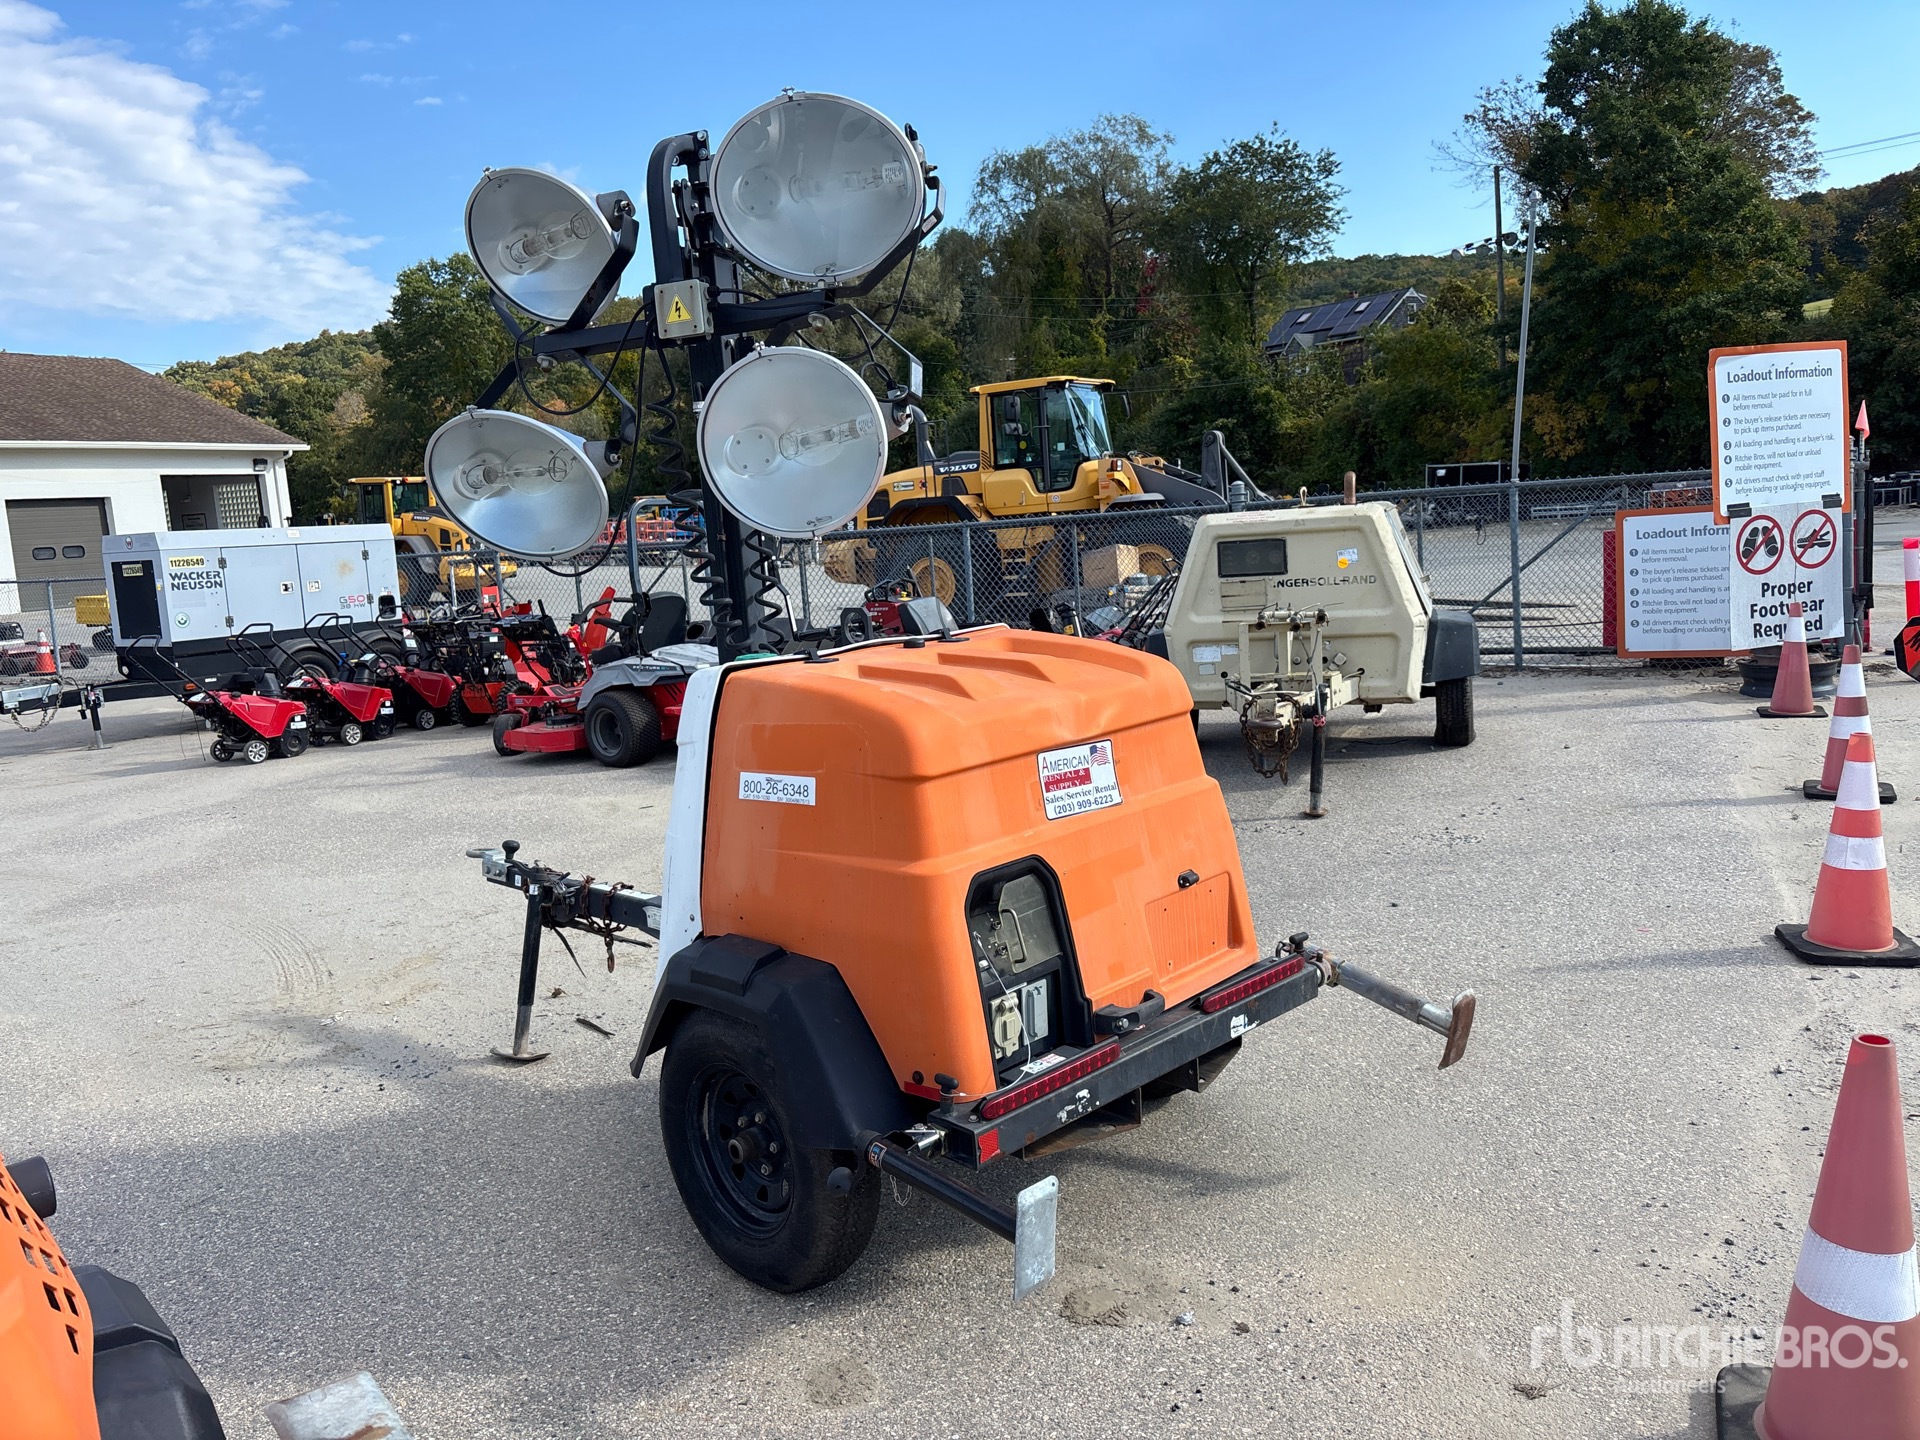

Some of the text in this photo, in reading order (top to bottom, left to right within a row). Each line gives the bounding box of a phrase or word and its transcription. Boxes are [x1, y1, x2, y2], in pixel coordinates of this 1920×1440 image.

[1727, 364, 1832, 383] Loadout Information
[1741, 393, 1756, 401] items
[1757, 392, 1770, 400] must
[1771, 391, 1778, 399] be
[1778, 390, 1790, 400] paid
[1732, 403, 1750, 411] before
[1734, 418, 1743, 426] The
[1744, 416, 1763, 426] buyer's
[1764, 415, 1782, 423] release
[1782, 414, 1798, 422] tickets
[1808, 412, 1831, 420] necessary
[1740, 426, 1751, 435] pick
[1753, 426, 1760, 434] up
[1743, 440, 1762, 448] loading
[1764, 438, 1773, 446] and
[1774, 437, 1796, 446] handling
[1808, 434, 1824, 443] buyer's
[938, 463, 978, 473] VOLVO
[1754, 462, 1782, 472] equipment.
[1802, 472, 1813, 480] yard
[1736, 486, 1752, 494] before
[1753, 485, 1772, 493] loading
[1780, 482, 1804, 491] unloading
[1636, 528, 1688, 540] Loadout
[1694, 546, 1708, 554] paid
[170, 558, 204, 568] 11226549
[168, 570, 222, 582] WACKER
[1654, 568, 1675, 576] buyer's
[1272, 575, 1376, 588] NGERSOLL-RAND
[1650, 576, 1662, 584] pick
[1690, 574, 1724, 582] purchased.
[170, 580, 223, 591] NEUSON
[1761, 580, 1813, 599] Proper
[339, 594, 366, 604] G50
[1664, 607, 1698, 615] equipment.
[1663, 626, 1686, 634] loading
[1753, 614, 1823, 640] Reqed
[1042, 754, 1090, 774] AMERICAN
[1043, 770, 1077, 782] RENTAL
[743, 780, 809, 798] 800-26-6348
[1046, 782, 1117, 804] Sales/Service/Rental
[1054, 794, 1114, 816] (203) 909-6223
